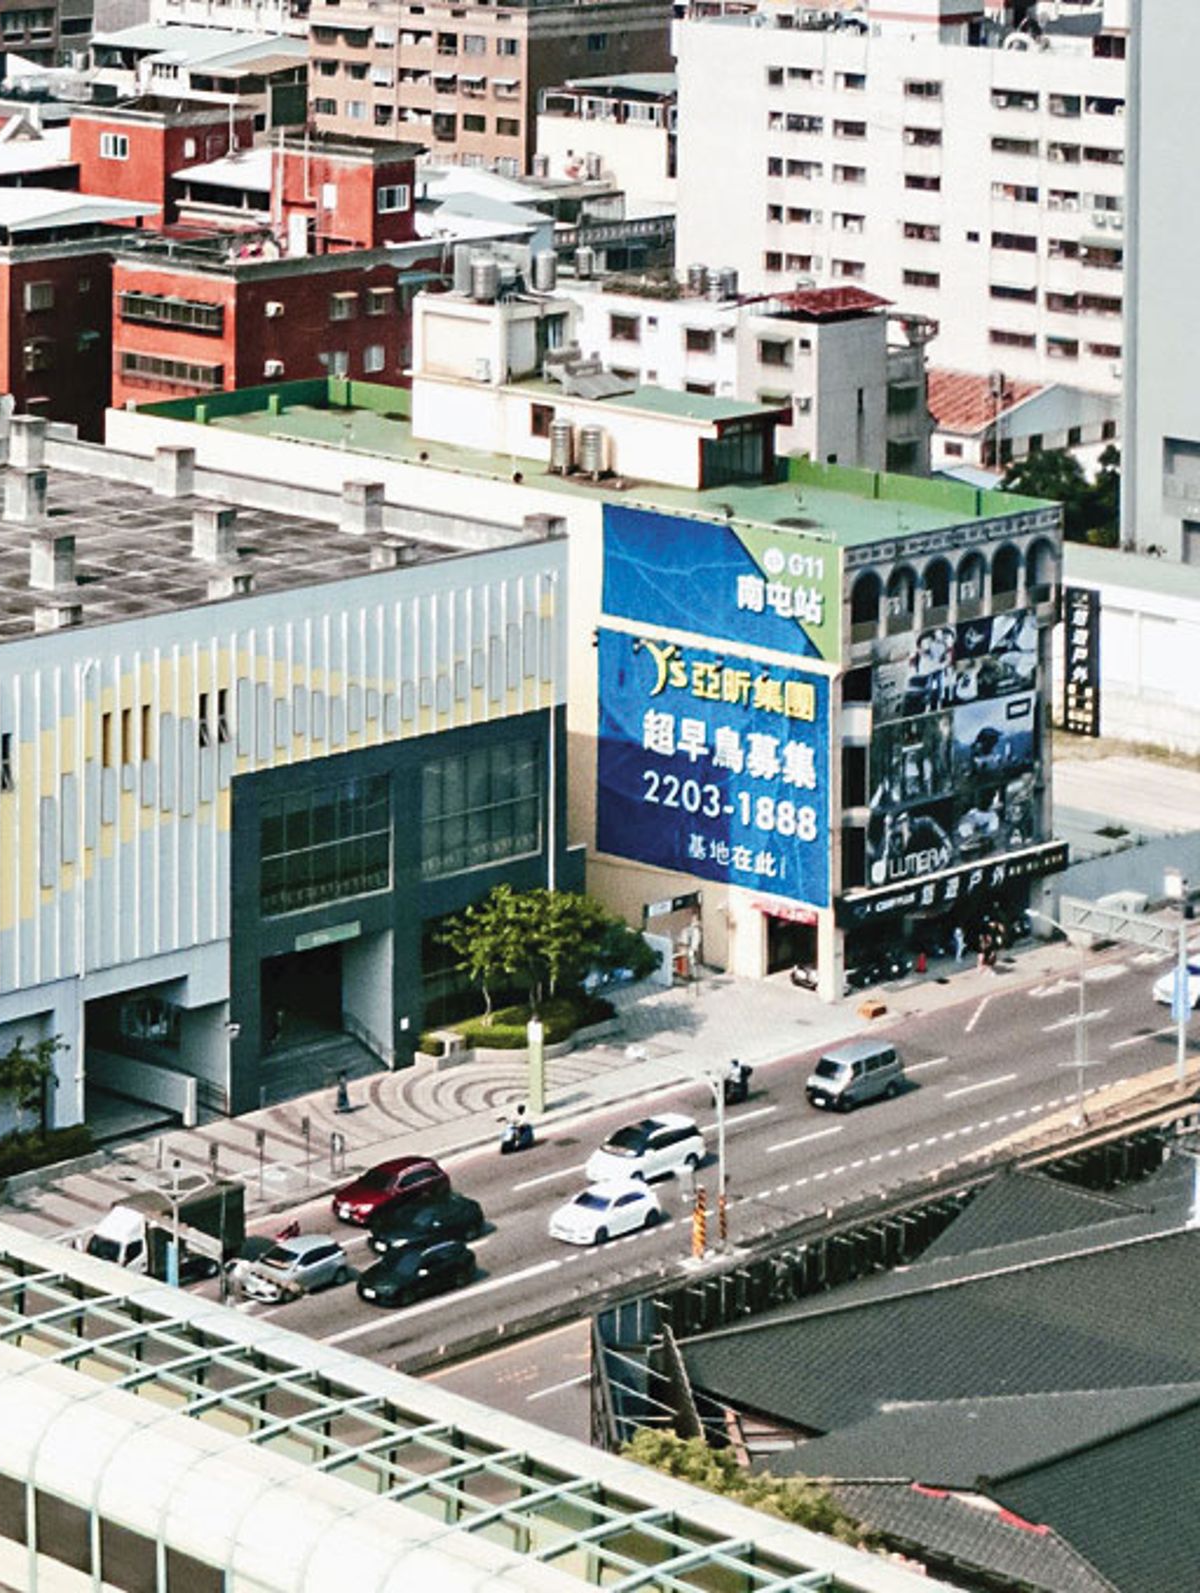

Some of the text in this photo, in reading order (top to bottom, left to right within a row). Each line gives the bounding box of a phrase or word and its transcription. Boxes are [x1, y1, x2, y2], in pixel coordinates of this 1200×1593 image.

[737, 574, 823, 624] 南屯站
[691, 661, 816, 722] 亞昕集團
[642, 708, 817, 790] 超早鳥募集
[642, 769, 818, 842] 2203-1888
